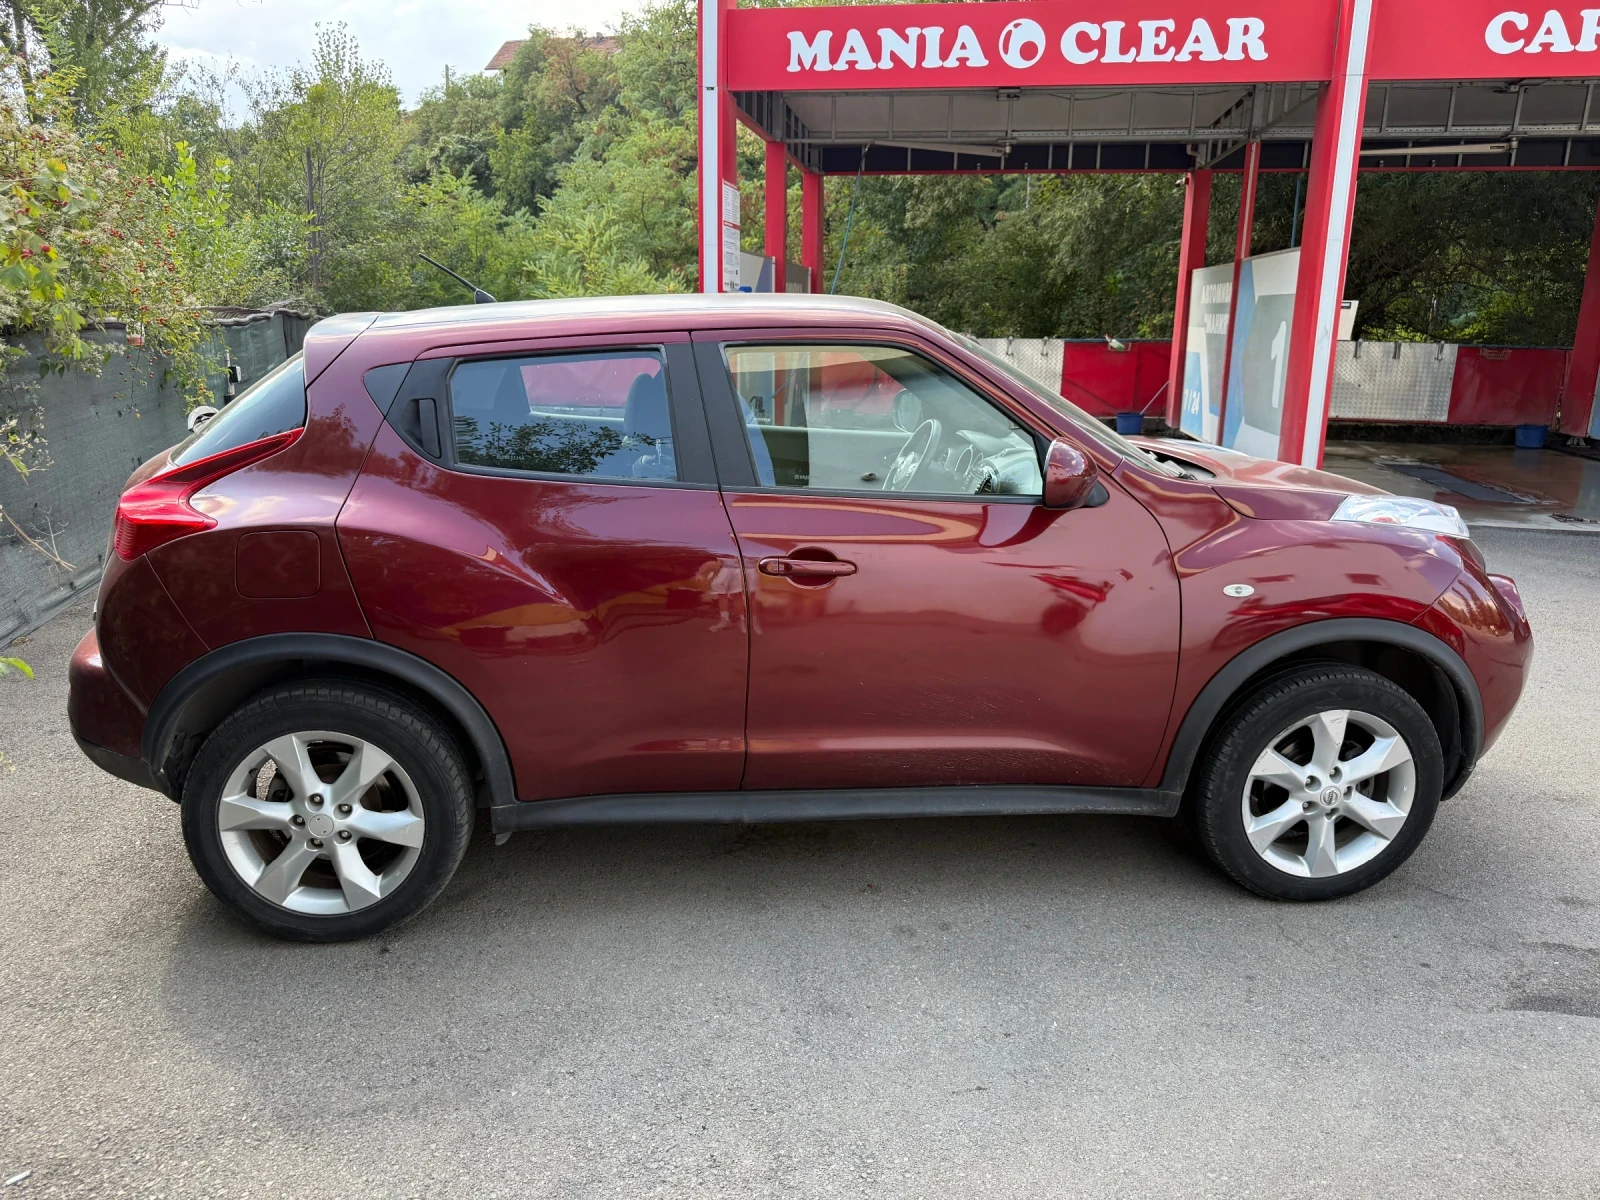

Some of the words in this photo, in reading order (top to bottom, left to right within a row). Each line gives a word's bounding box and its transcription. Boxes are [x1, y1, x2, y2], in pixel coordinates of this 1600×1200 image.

[786, 24, 990, 73] MANIA
[1060, 16, 1269, 65] CLEAR
[1200, 282, 1232, 304] АВТОМИВ
[1271, 320, 1287, 408] 1
